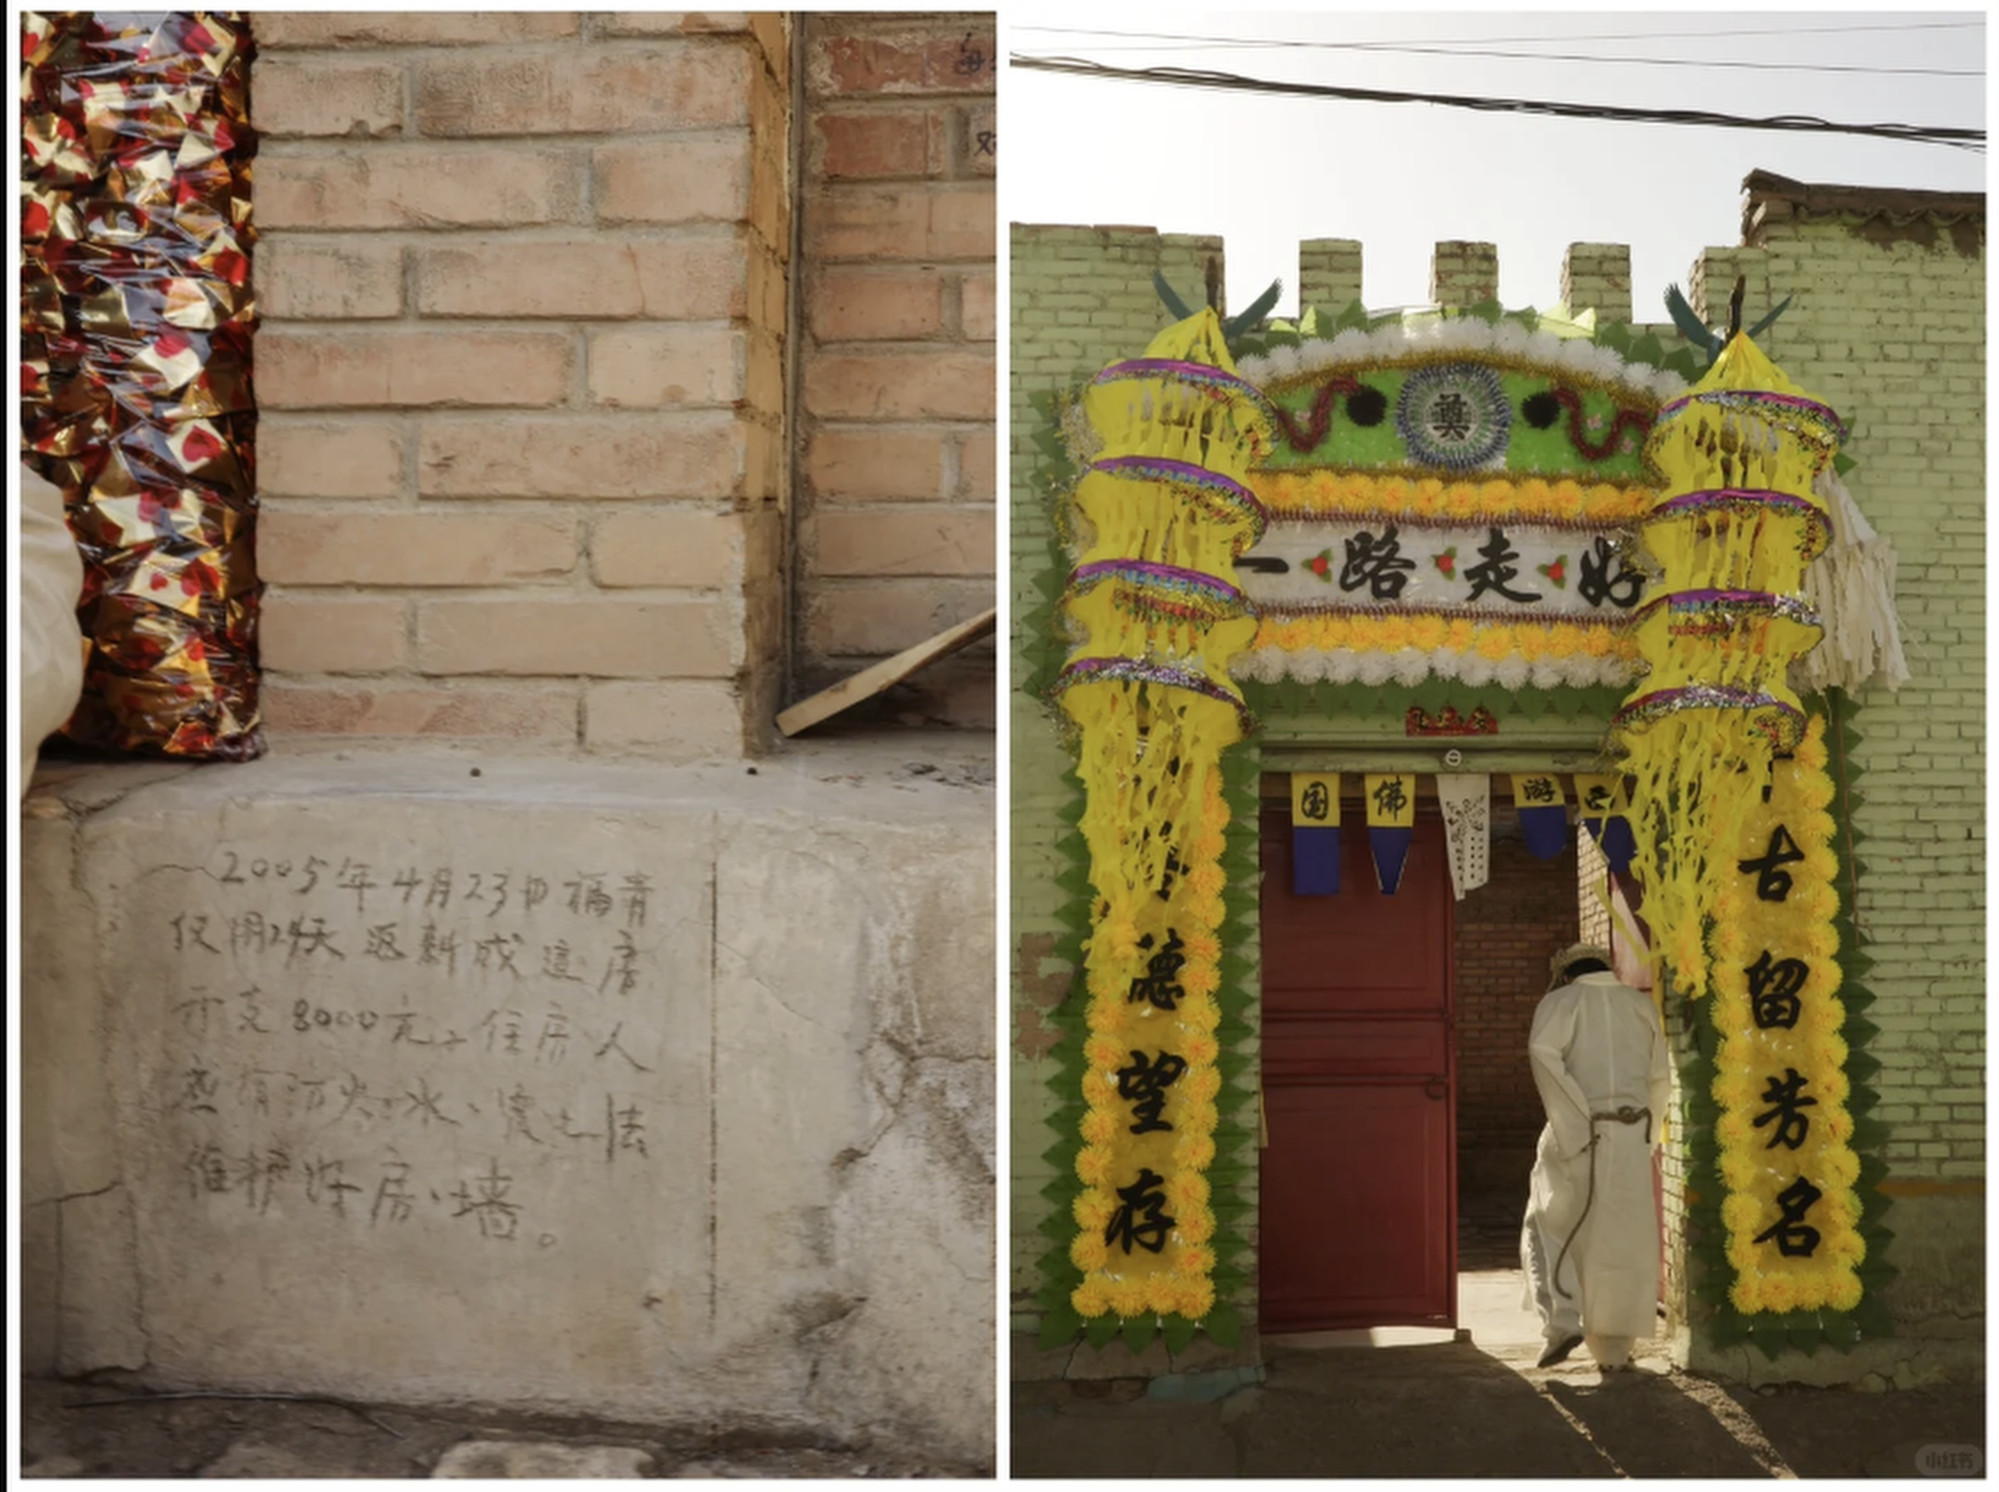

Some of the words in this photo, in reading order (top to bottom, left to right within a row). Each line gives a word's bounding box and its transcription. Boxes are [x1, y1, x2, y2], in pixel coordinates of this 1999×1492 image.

[1432, 393, 1470, 440] 奠
[1234, 524, 1647, 608] 一路走好
[1301, 780, 1330, 822] 国
[1373, 776, 1407, 822] 佛
[1521, 775, 1555, 802] 游
